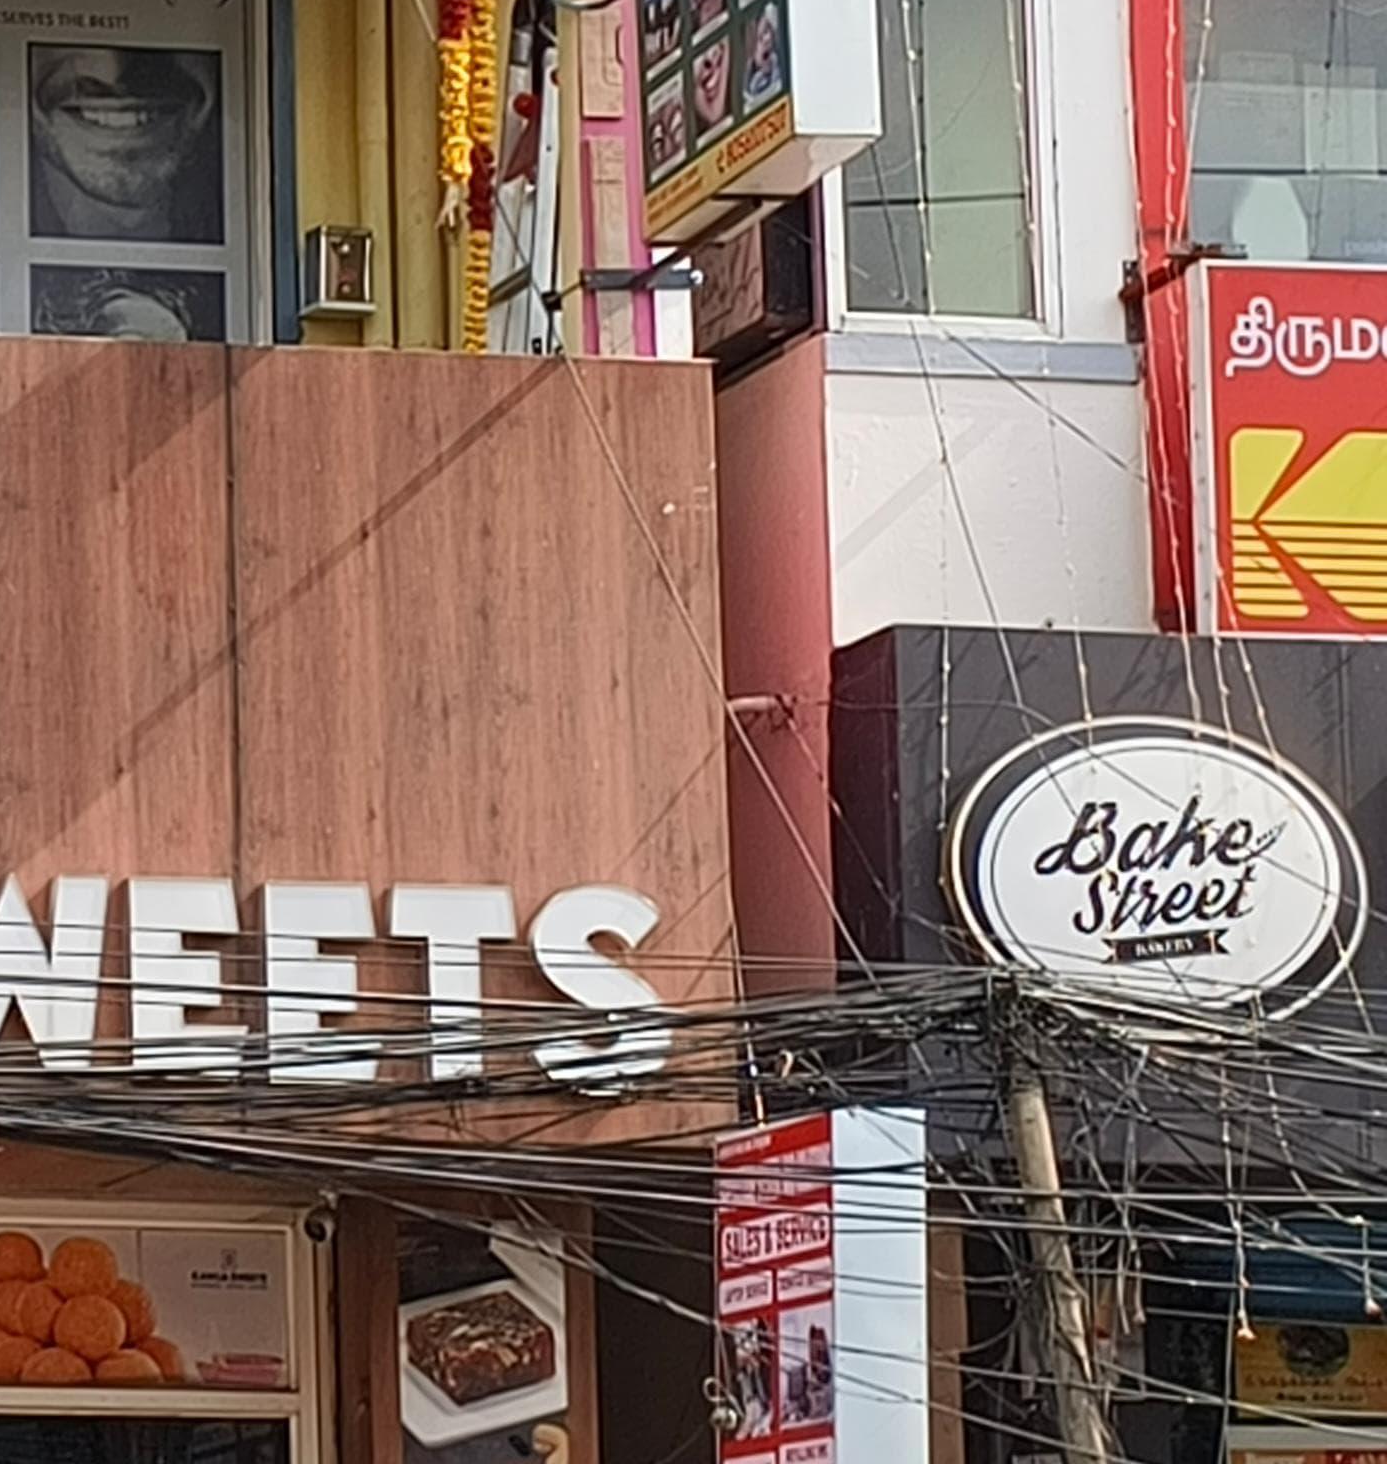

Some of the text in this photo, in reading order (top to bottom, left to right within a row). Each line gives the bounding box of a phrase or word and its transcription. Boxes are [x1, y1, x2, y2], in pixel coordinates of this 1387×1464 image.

[58, 12, 85, 28] THE
[1225, 296, 1387, 377] திரும
[1033, 791, 1287, 876] Bake
[1073, 865, 1255, 935] Street
